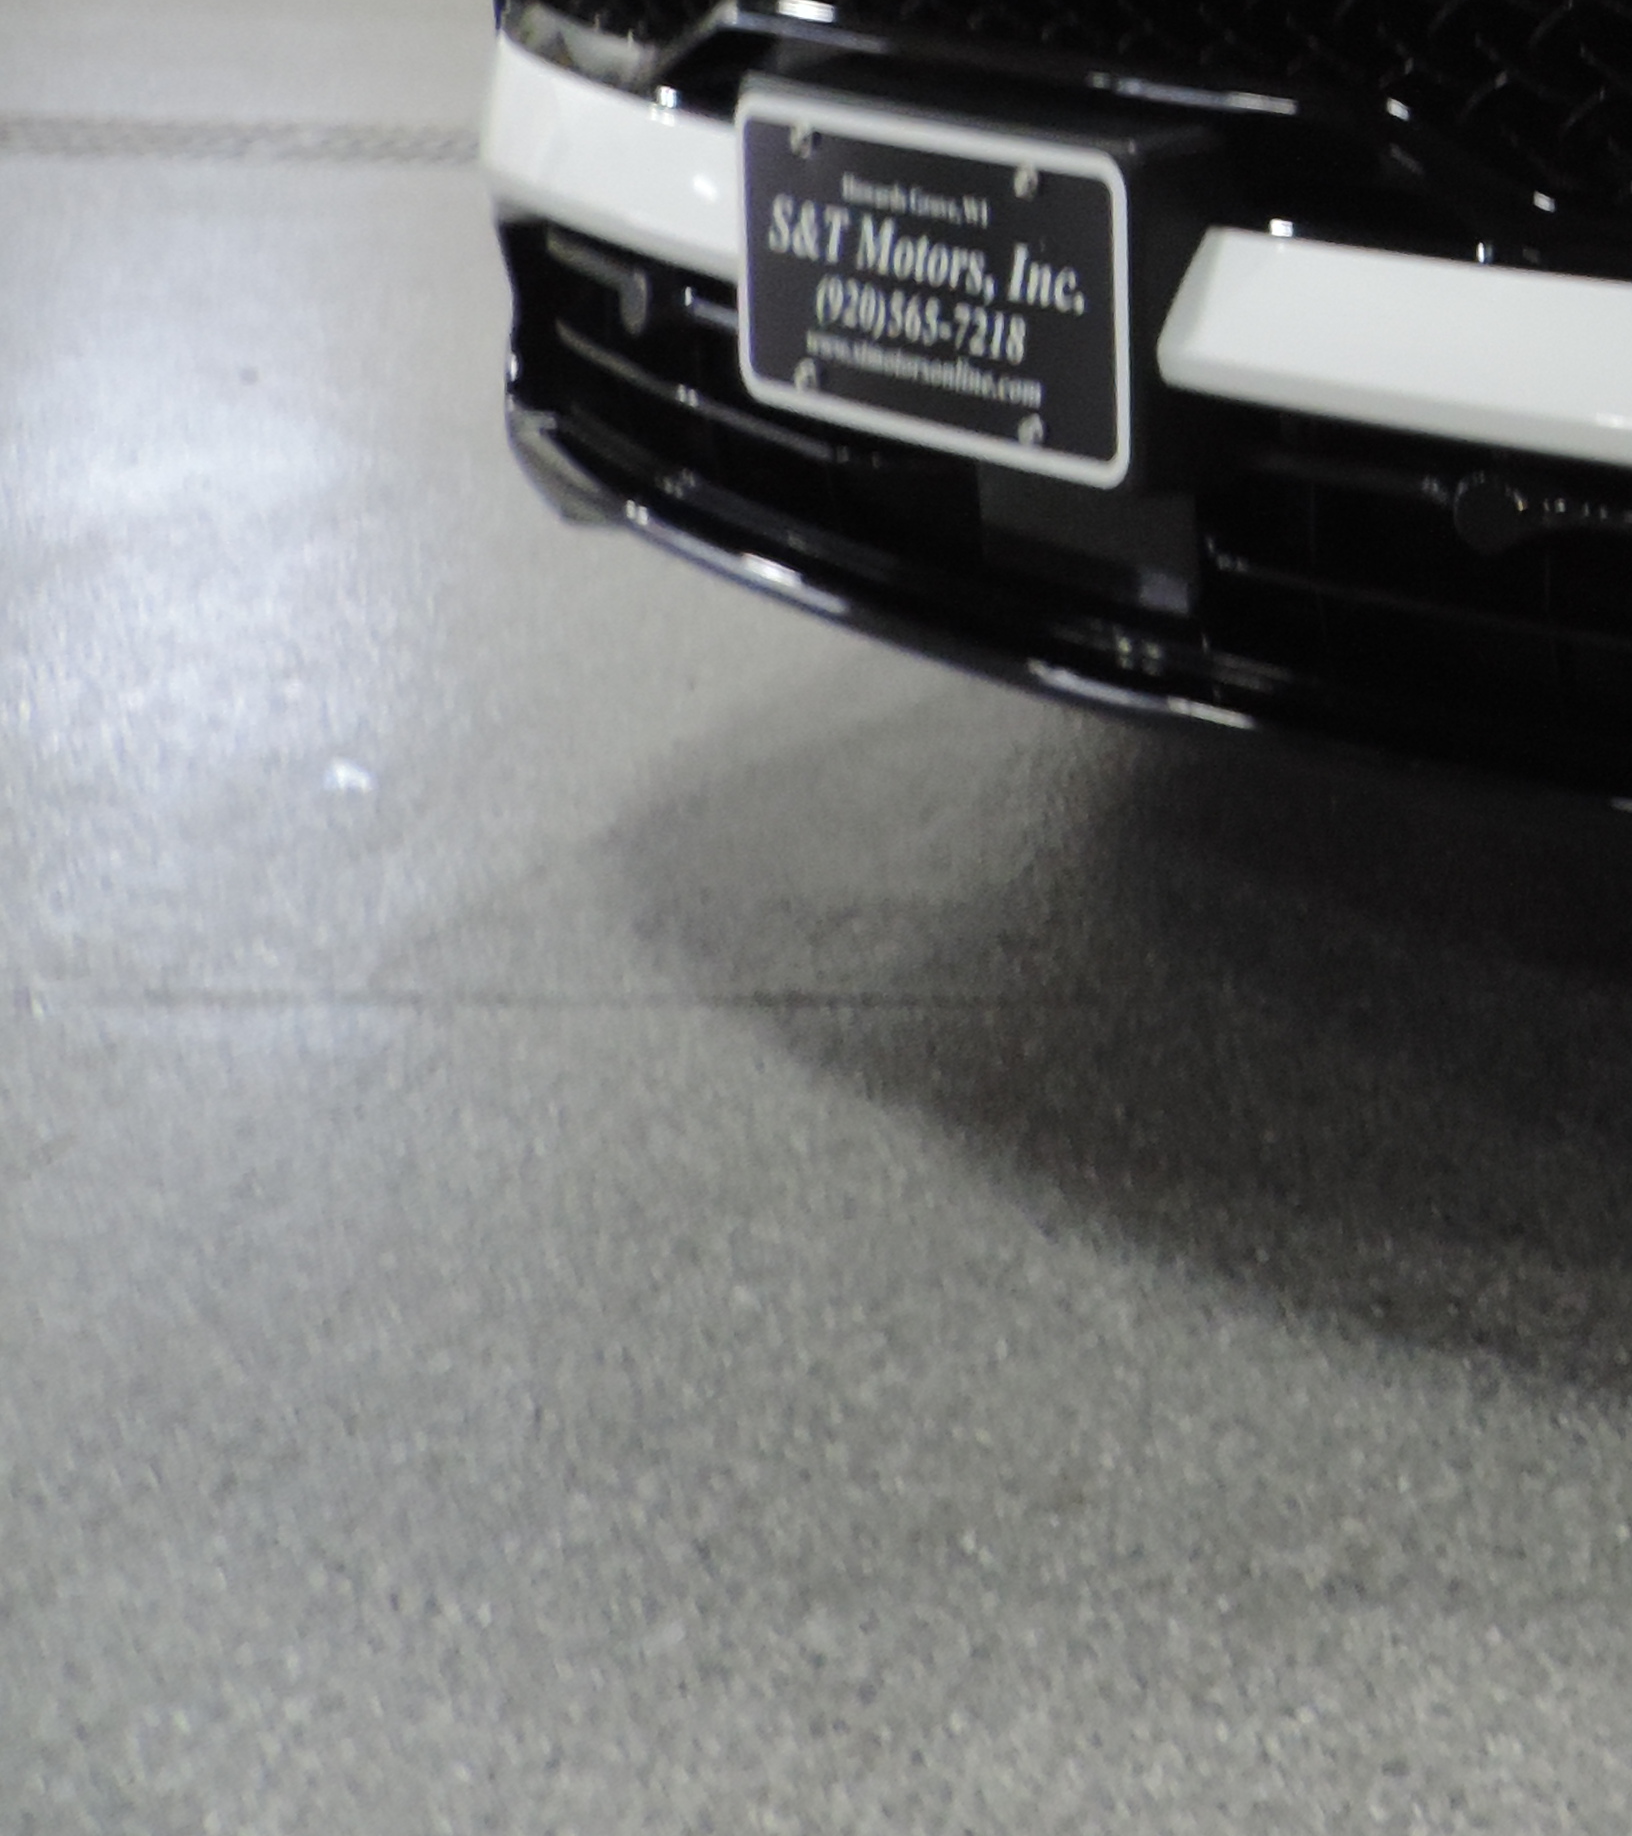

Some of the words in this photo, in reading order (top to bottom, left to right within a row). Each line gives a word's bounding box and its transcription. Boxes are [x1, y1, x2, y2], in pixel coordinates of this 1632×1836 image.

[769, 193, 850, 263] S&T
[857, 212, 995, 304] Motors,
[1008, 242, 1086, 316] Inc.
[815, 272, 1027, 365] (920)565-7218
